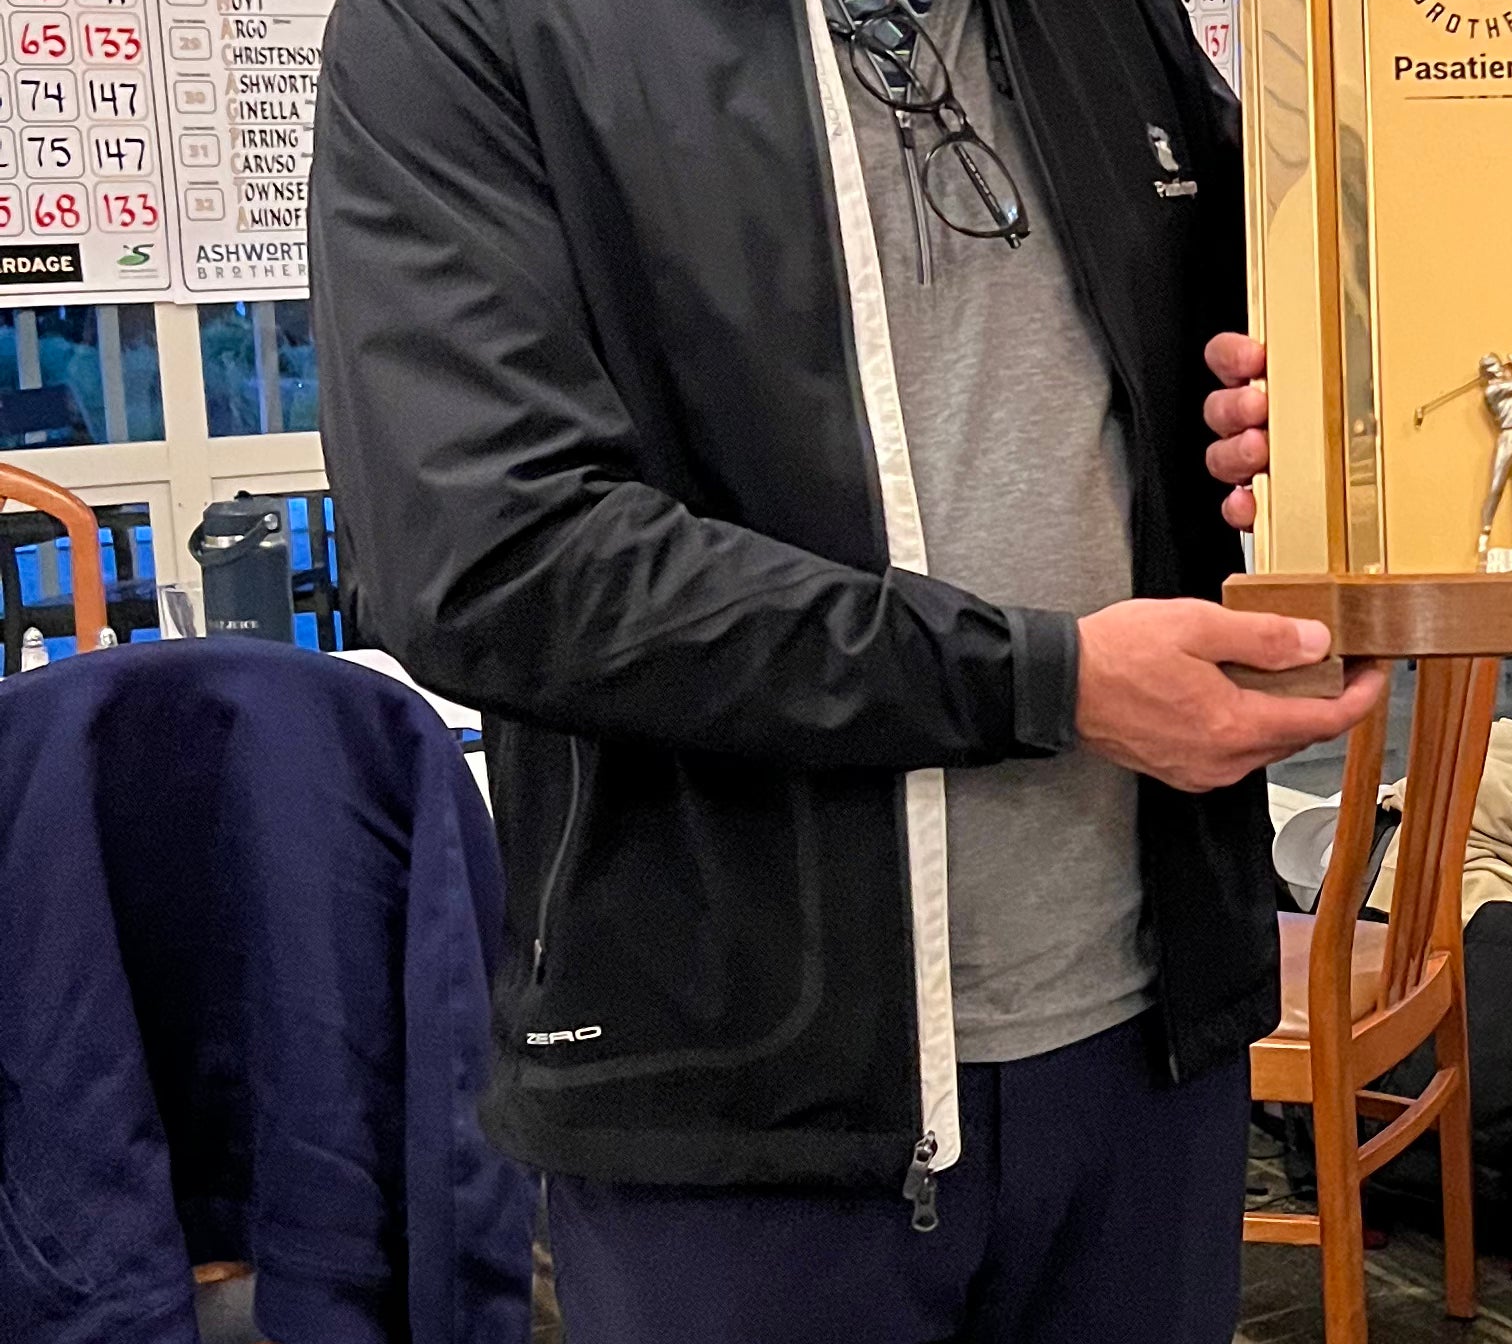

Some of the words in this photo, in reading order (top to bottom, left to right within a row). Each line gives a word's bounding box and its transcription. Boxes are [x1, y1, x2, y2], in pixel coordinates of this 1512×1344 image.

[220, 17, 267, 41] ARGO
[20, 23, 67, 57] 65
[85, 23, 141, 61] 133
[20, 79, 65, 113] 74
[89, 79, 137, 117] 147
[226, 98, 300, 122] GINELLA
[27, 136, 71, 168] 75
[95, 137, 145, 171] 147
[233, 179, 306, 203] TOWNSE
[35, 193, 80, 228] 68
[103, 193, 157, 227] 133
[196, 242, 306, 263] ASHWORT
[198, 264, 306, 281] BROTHER
